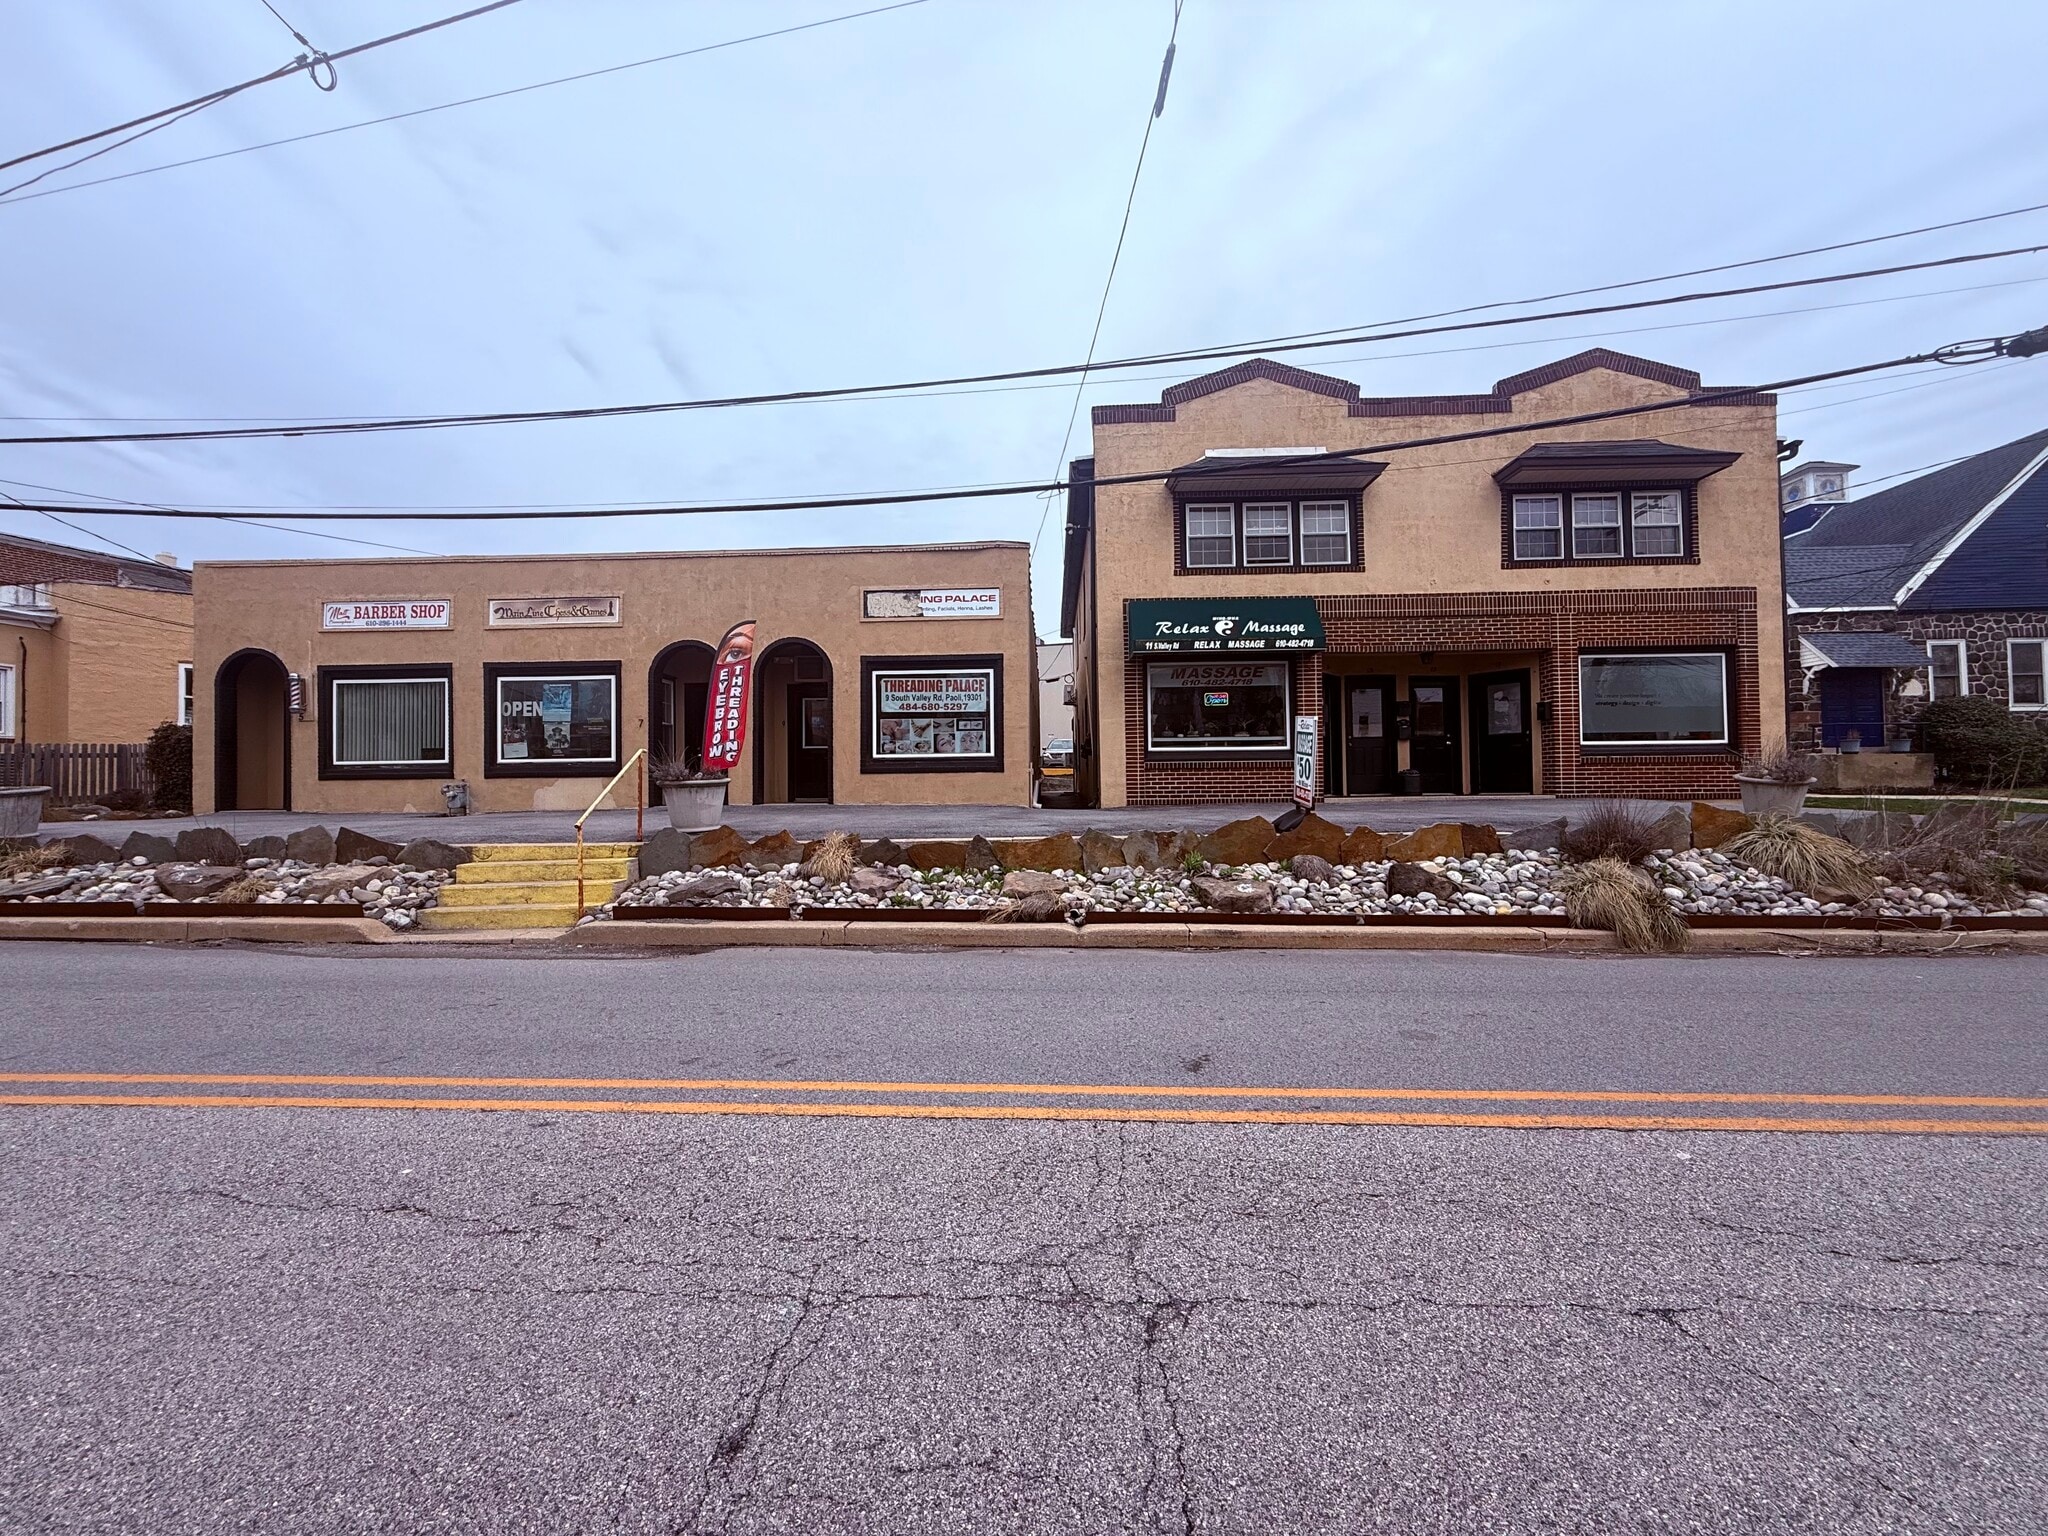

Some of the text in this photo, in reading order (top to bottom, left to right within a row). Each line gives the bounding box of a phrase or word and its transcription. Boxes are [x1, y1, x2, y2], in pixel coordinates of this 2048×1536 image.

[945, 594, 996, 602] PALACE
[354, 606, 407, 619] BARBER
[411, 605, 445, 618] SHOP
[525, 607, 543, 617] Line
[1155, 620, 1305, 636] Relax Massage
[1145, 642, 1153, 650] 11
[1194, 641, 1221, 649] RELAX
[1228, 640, 1265, 648] MASSAGE
[1275, 639, 1314, 648] 610-482-4718
[1171, 667, 1265, 679] MASSAGE
[883, 679, 985, 693] THREADING PALACE
[891, 694, 910, 702] South
[911, 694, 931, 703] Valley
[932, 694, 944, 702] Rd,
[502, 701, 543, 717] OPEN
[898, 703, 969, 711] 484-680-5297
[709, 668, 730, 759] EYEBROW
[725, 665, 745, 762] THREADING
[638, 718, 644, 729] 7
